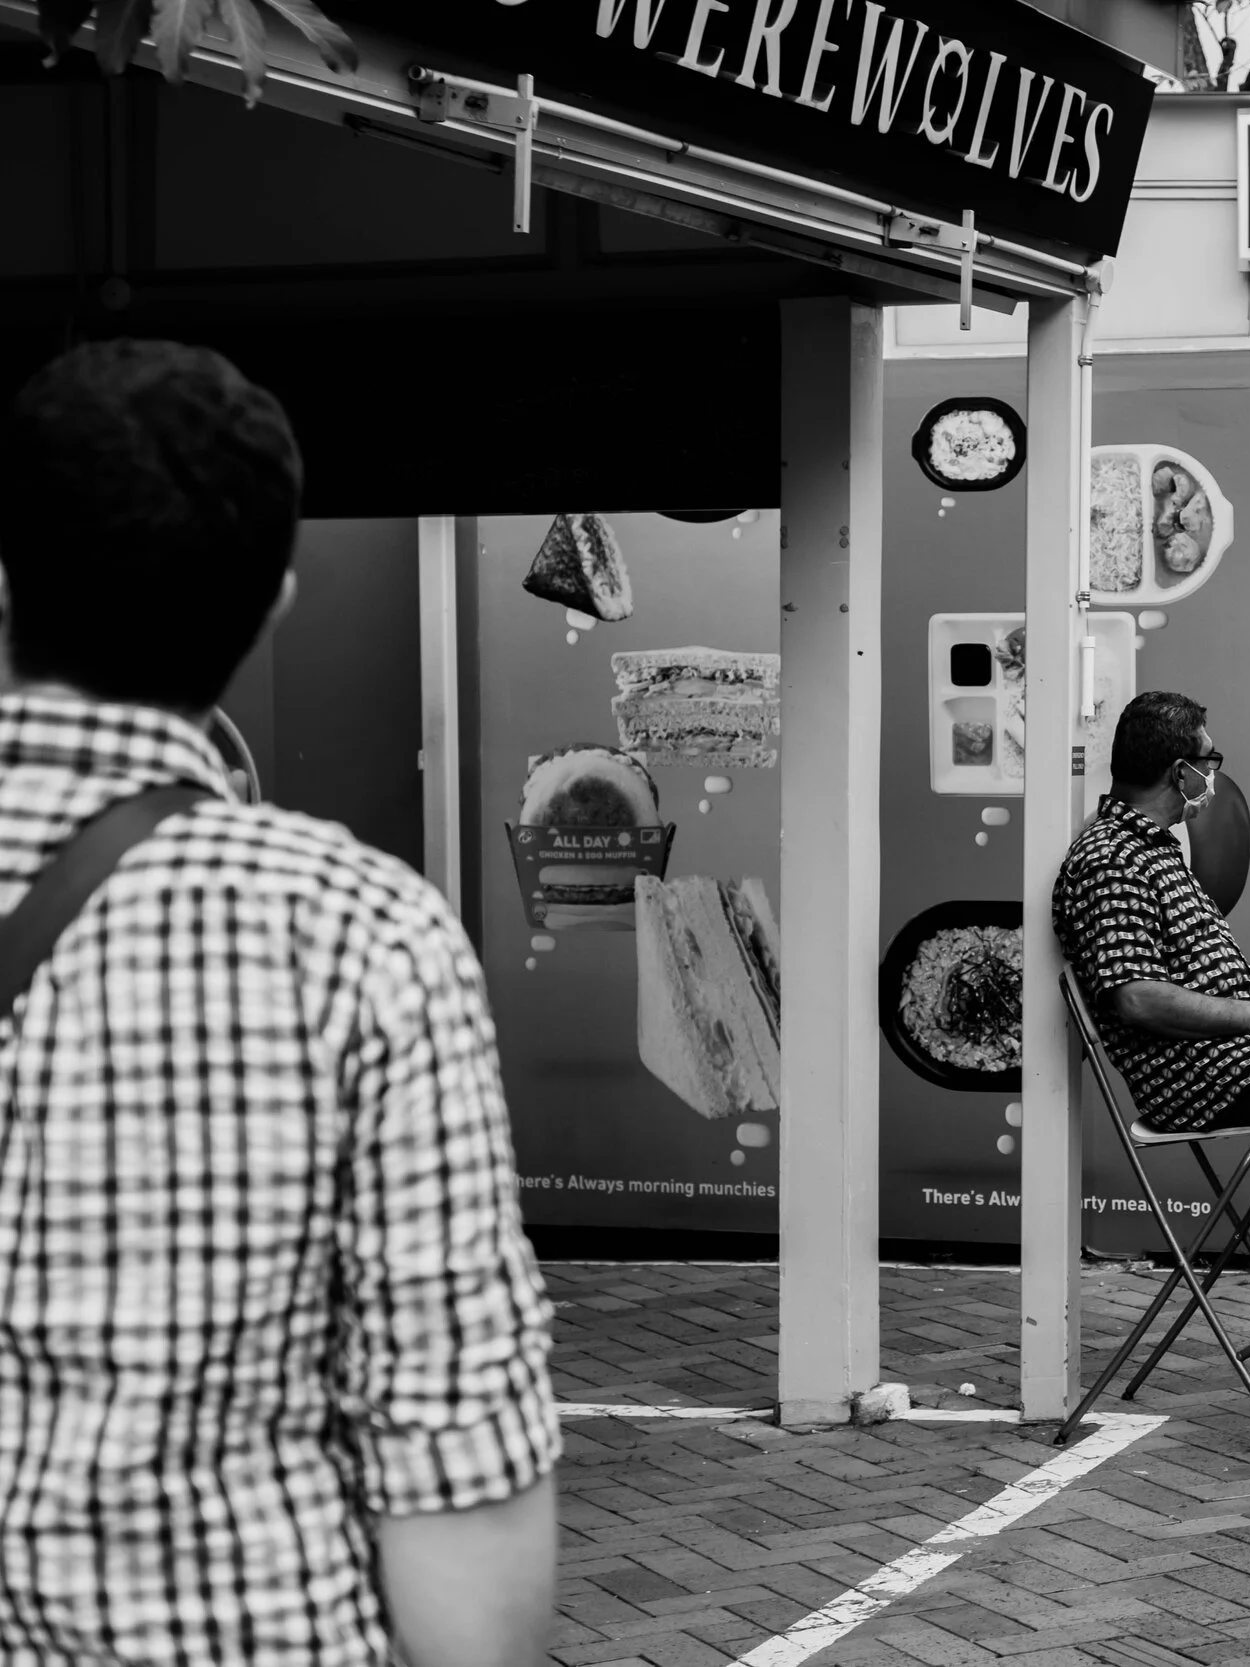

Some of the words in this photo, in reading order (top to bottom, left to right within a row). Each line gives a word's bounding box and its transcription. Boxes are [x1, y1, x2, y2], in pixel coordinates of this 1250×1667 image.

[553, 836, 581, 848] ALL
[584, 836, 611, 848] DAY
[538, 850, 576, 859] CHICKEN
[513, 1173, 564, 1190] here's
[567, 1174, 625, 1195] Always
[628, 1178, 694, 1198] morning
[698, 1180, 776, 1198] munchies
[922, 1188, 984, 1206] There's
[988, 1190, 1022, 1207] Alw
[1080, 1195, 1107, 1214] rty
[1167, 1197, 1212, 1217] to-go
